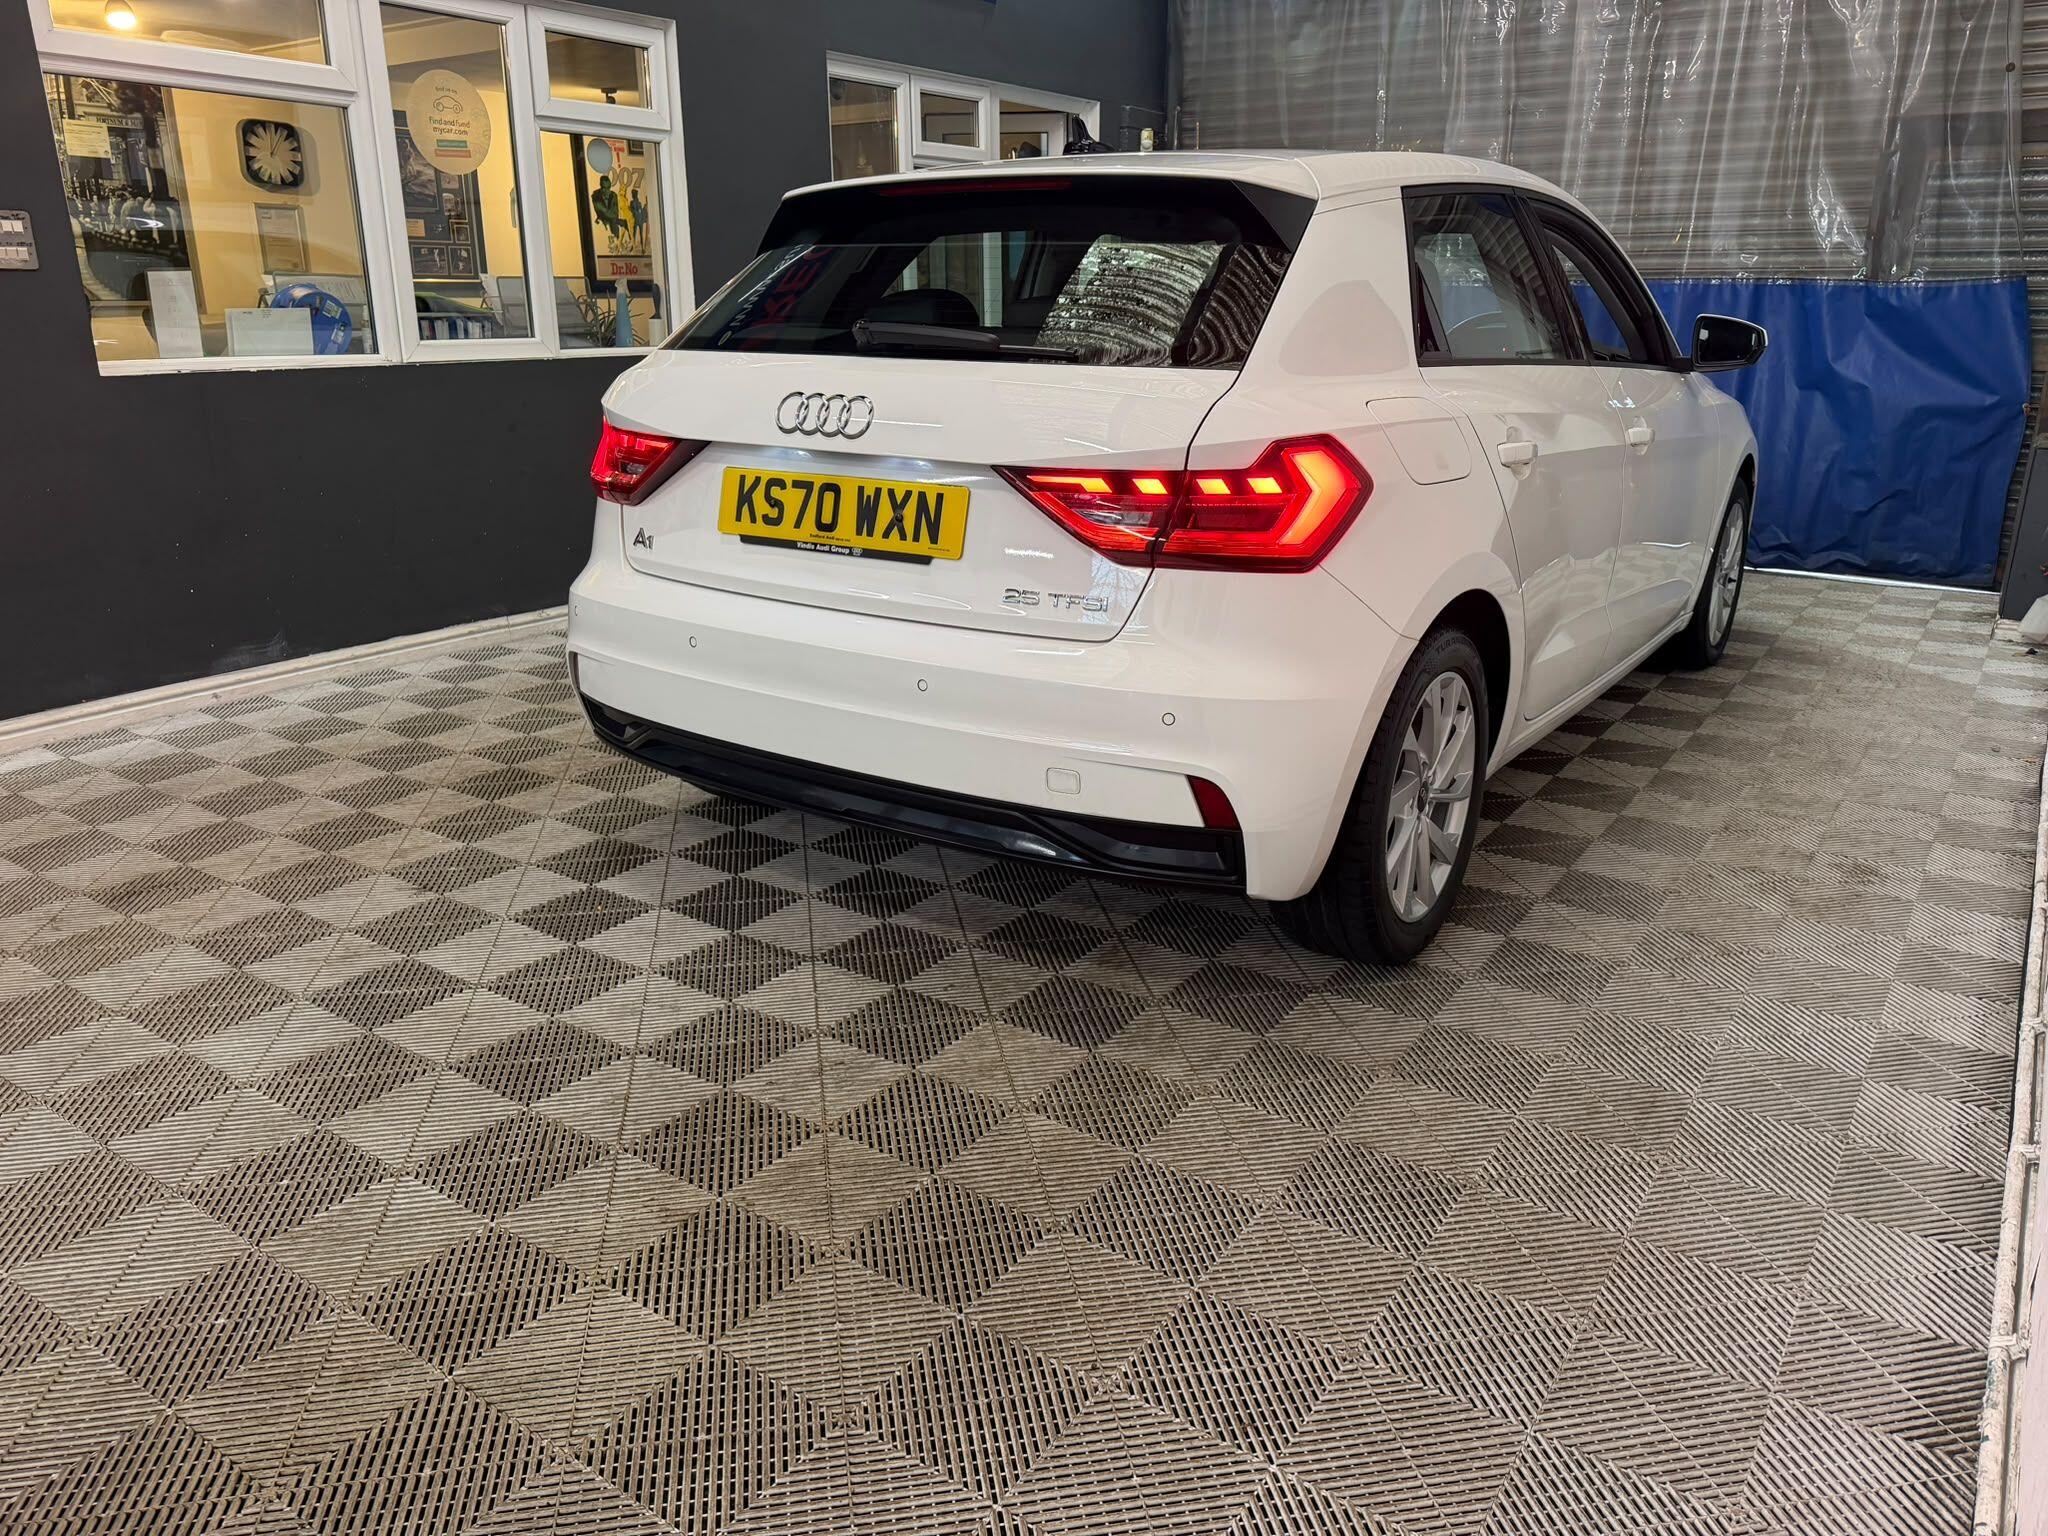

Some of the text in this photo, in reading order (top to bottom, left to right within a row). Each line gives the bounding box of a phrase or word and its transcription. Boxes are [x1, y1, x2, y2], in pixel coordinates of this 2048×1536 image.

[608, 166, 645, 188] 007
[735, 474, 945, 545] KS70 WXN
[633, 527, 655, 550] A1
[816, 544, 830, 552] Audi
[830, 545, 850, 555] Group
[1002, 588, 1109, 613] 25 TFSI
